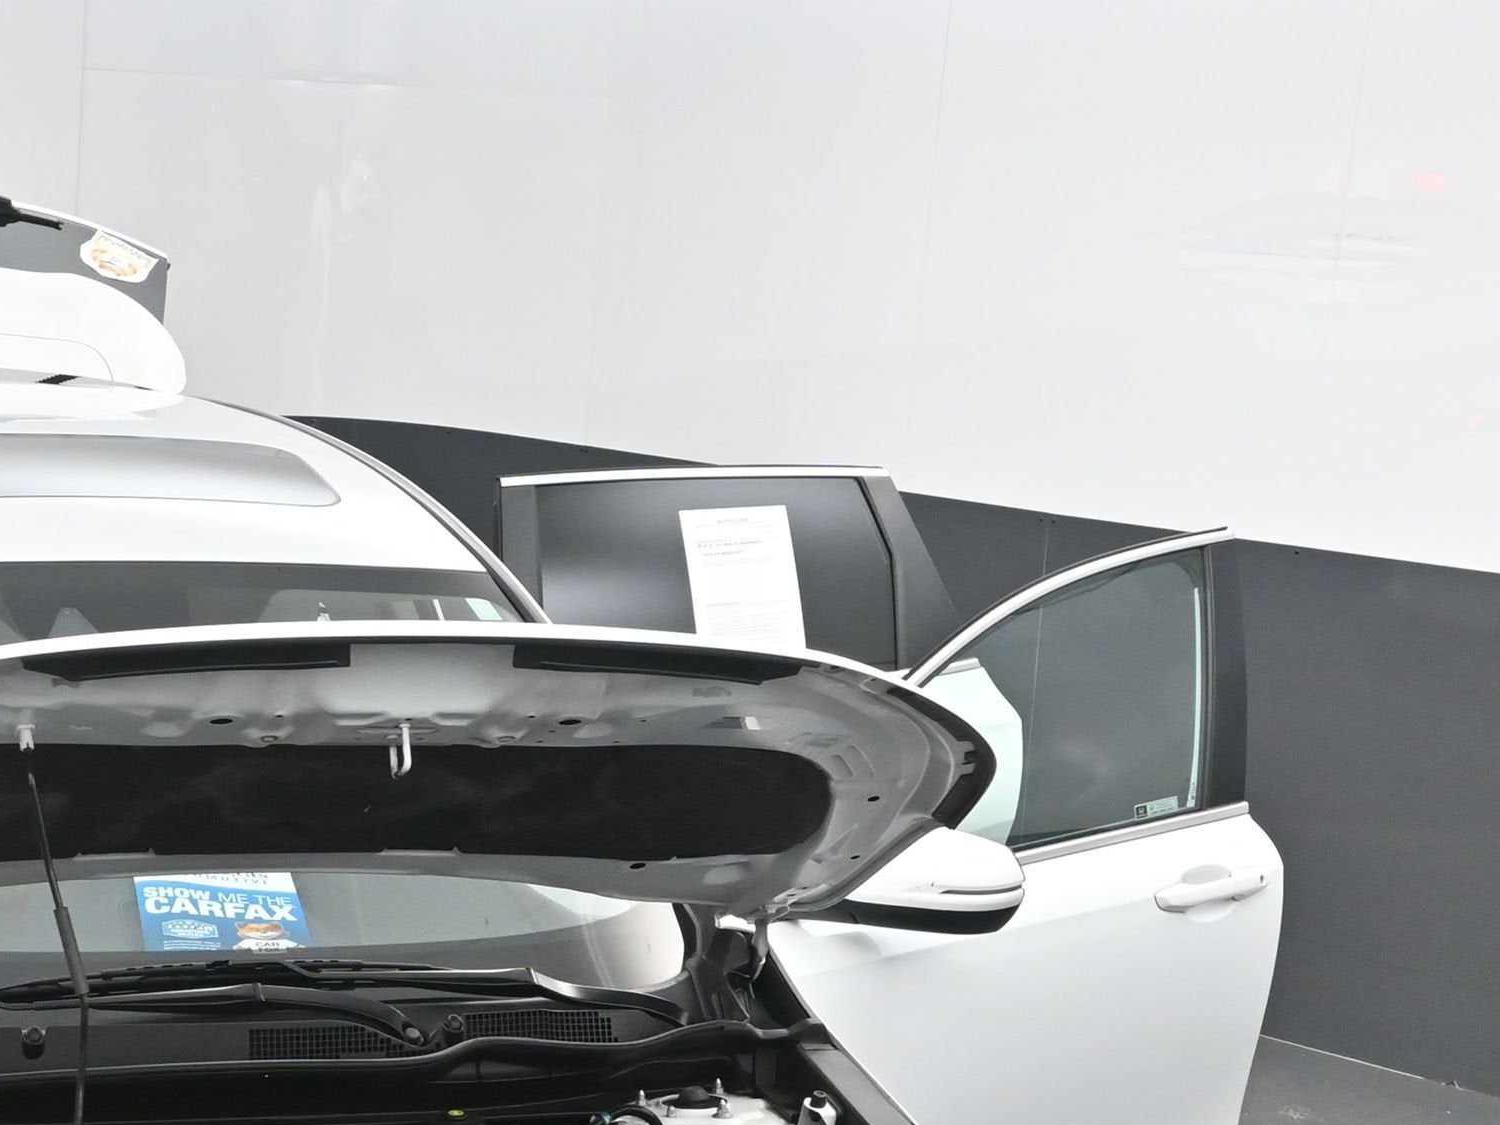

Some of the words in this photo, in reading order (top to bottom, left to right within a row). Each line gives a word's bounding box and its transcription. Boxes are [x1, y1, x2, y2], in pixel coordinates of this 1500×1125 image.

[143, 886, 211, 900] SHOW
[218, 892, 249, 905] ME
[252, 894, 292, 907] THE
[145, 896, 299, 921] CARFAX
